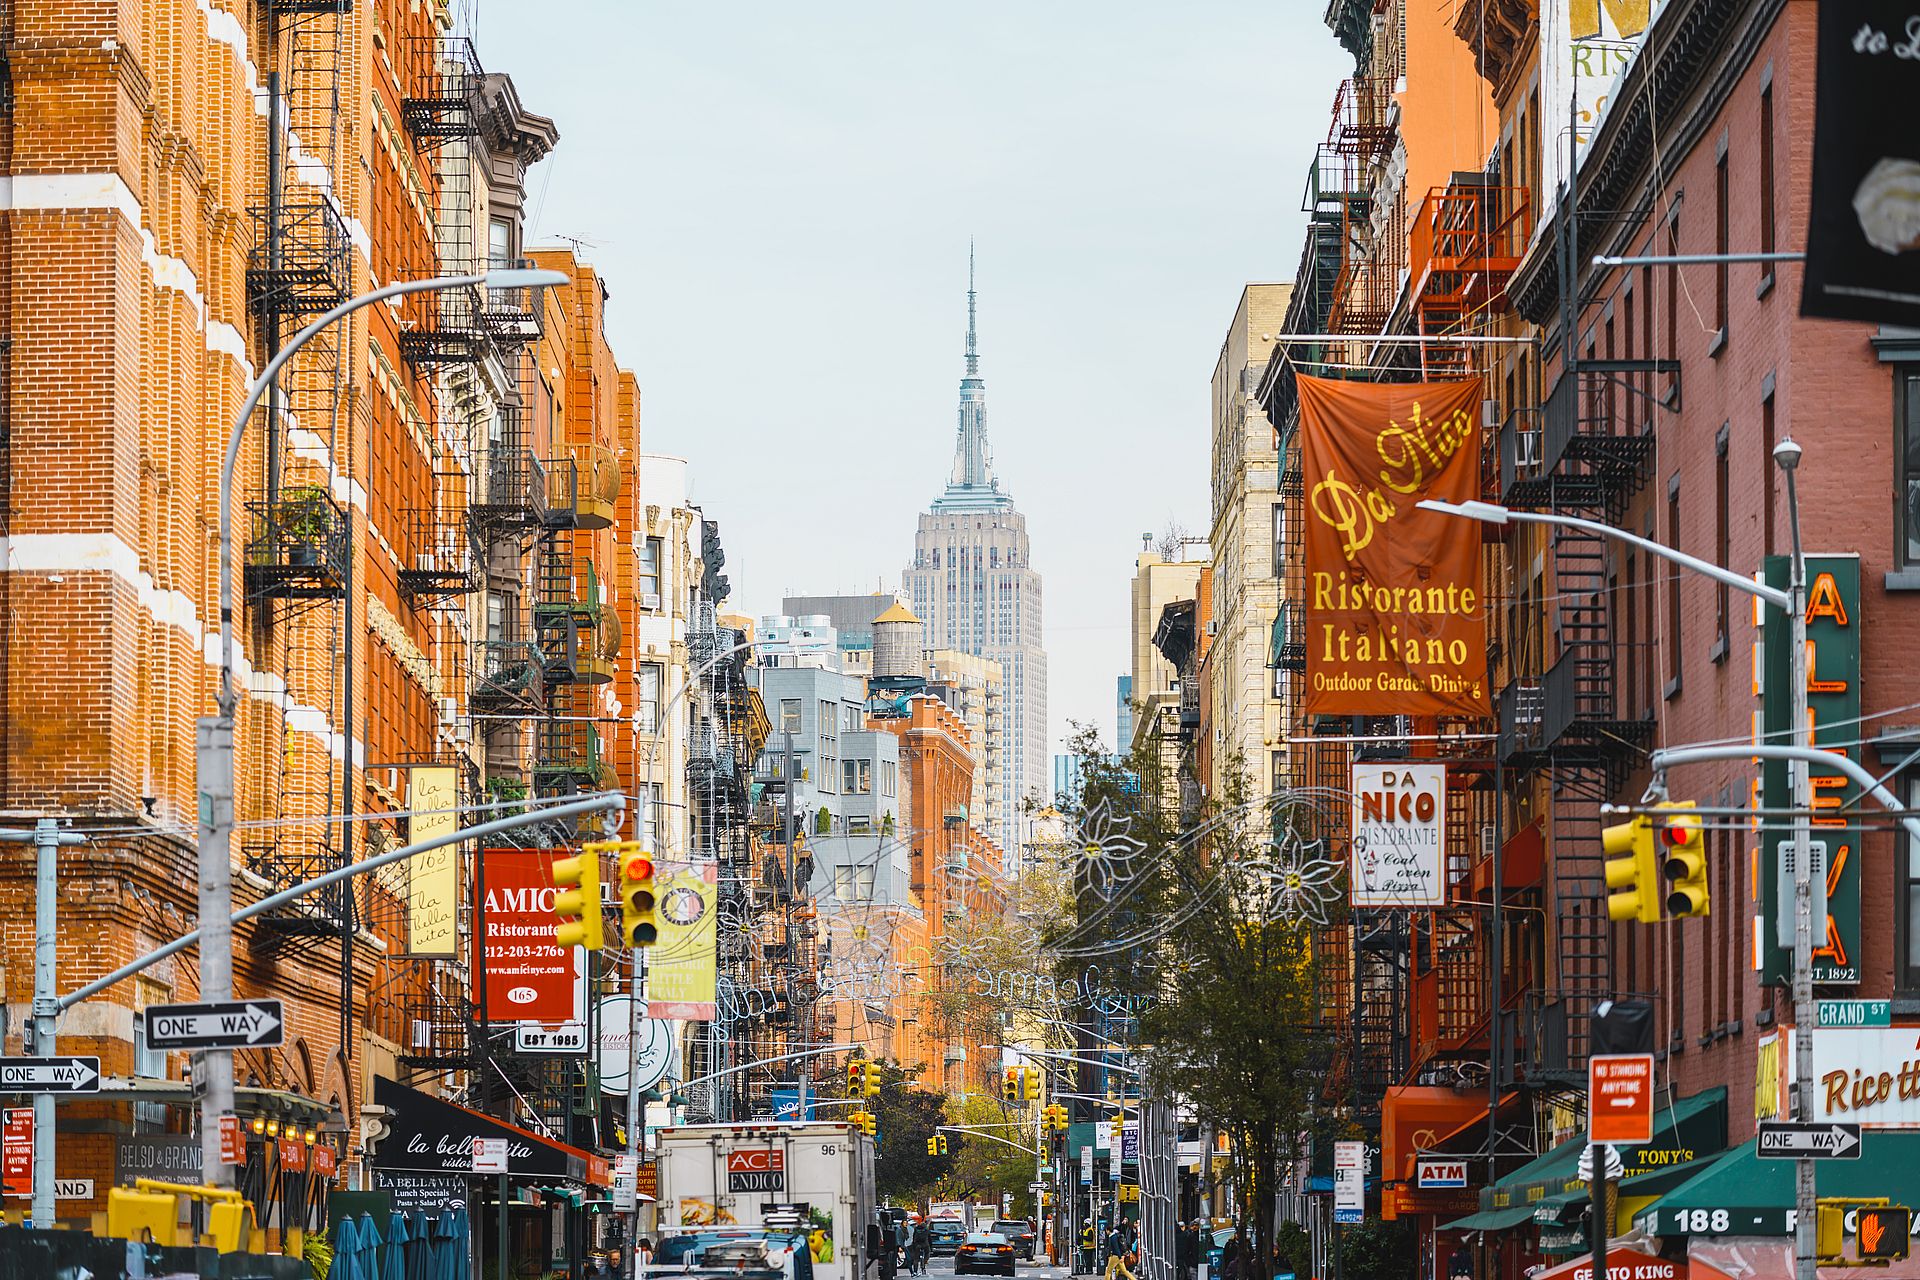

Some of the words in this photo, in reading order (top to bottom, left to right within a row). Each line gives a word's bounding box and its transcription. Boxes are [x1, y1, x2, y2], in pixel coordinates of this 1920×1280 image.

[1311, 469, 1396, 562] Da
[1376, 401, 1473, 493] Nico
[1313, 571, 1476, 614] Ristorante
[1322, 624, 1468, 665] Italiano
[1313, 671, 1373, 691] Outdoor
[1377, 672, 1426, 691] Garden
[1430, 674, 1482, 699] Dining
[418, 777, 441, 797] la
[1382, 771, 1416, 787] DA
[1362, 792, 1435, 823] NICO
[1360, 828, 1437, 845] RISTORANTE
[419, 846, 447, 871] 163
[1383, 853, 1418, 866] Coal
[418, 890, 441, 910] la
[484, 888, 568, 913] AMIC
[1828, 967, 1855, 980] 1892
[513, 990, 532, 1000] 165
[1820, 1003, 1864, 1024] GRAND
[1871, 1004, 1887, 1015] ST
[158, 1018, 198, 1036] ONE
[221, 1015, 264, 1033] WAY
[525, 1034, 547, 1045] EST
[551, 1035, 578, 1045] 1985
[5, 1068, 36, 1081] ONE
[52, 1068, 85, 1081] WAY
[1595, 1064, 1608, 1077] NO
[1609, 1063, 1648, 1077] STANDING
[1600, 1080, 1642, 1094] ANYTIME
[407, 1133, 430, 1154] la
[436, 1134, 480, 1156] bell
[507, 1142, 534, 1158] ita
[1764, 1133, 1793, 1147] ONE
[1812, 1133, 1846, 1148] WAY
[121, 1144, 154, 1168] GELSO
[157, 1150, 163, 1165] &
[821, 1144, 836, 1156] 96
[1637, 1149, 1694, 1165] TONY'S
[730, 1153, 781, 1169] ACE
[177, 1176, 200, 1184] DINNER
[1338, 1170, 1343, 1181] 2
[1421, 1166, 1464, 1179] ATM
[379, 1178, 394, 1188] LA
[397, 1178, 436, 1189] BELLA
[437, 1177, 466, 1189] VITA
[616, 1178, 622, 1187] 2
[731, 1173, 782, 1190] ENDICO
[395, 1189, 419, 1197] Lunch
[419, 1189, 450, 1199] Specials
[419, 1199, 436, 1207] Salad
[1674, 1208, 1730, 1232] 188
[1212, 1256, 1219, 1266] P
[1573, 1266, 1631, 1280] GEATO
[1634, 1265, 1674, 1280] KING
